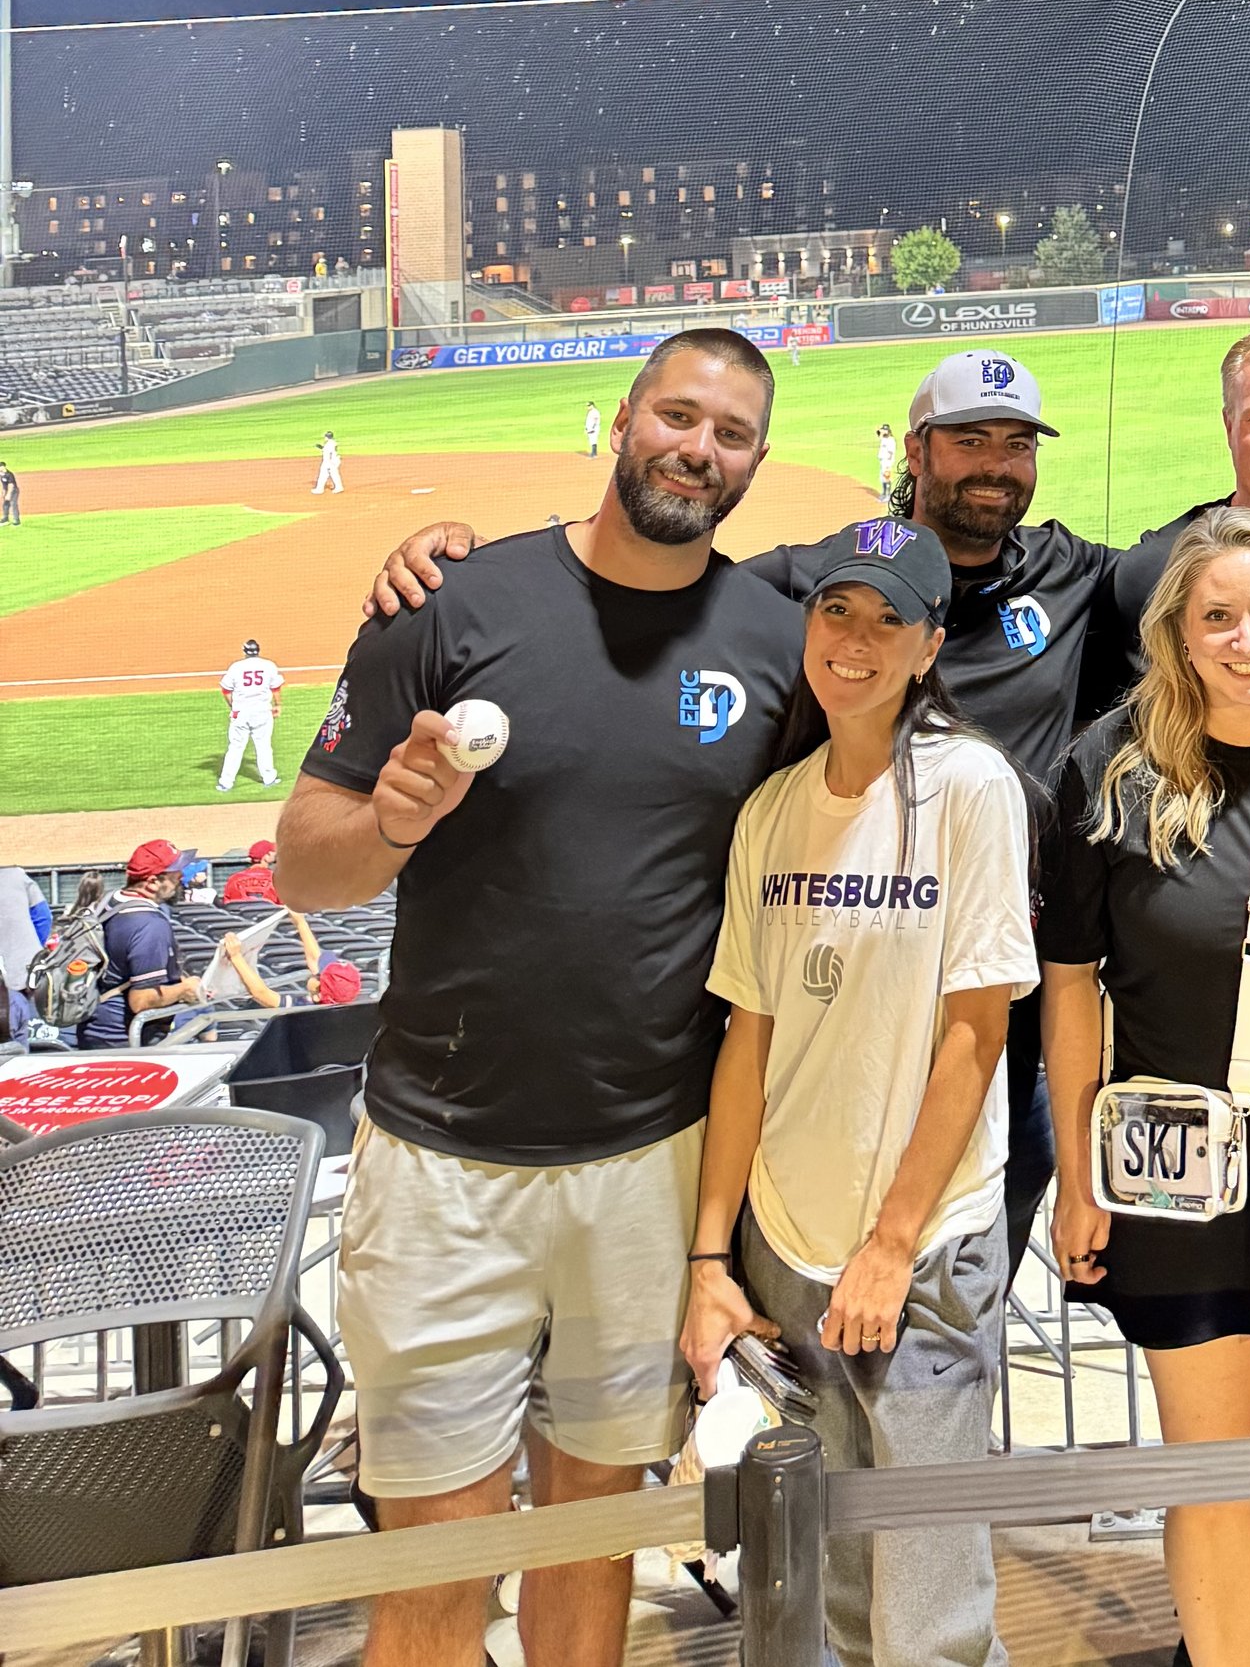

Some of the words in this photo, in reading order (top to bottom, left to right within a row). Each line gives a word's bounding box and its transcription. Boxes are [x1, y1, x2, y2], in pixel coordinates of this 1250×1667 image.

[939, 302, 1037, 322] LEXUS
[1176, 305, 1209, 314] INTREPID
[940, 322, 958, 332] OF
[960, 318, 1037, 331] HUNTSVILLE
[453, 347, 492, 365] GET
[494, 343, 546, 362] YOUR
[549, 340, 607, 359] GEAR!
[981, 359, 994, 384] EPIC
[854, 520, 918, 560] W
[996, 600, 1025, 650] EPIC
[242, 670, 264, 687] 55
[678, 669, 701, 727] EPIC
[761, 872, 941, 911] WHITESBURG
[765, 907, 930, 931] OLLEYBALL
[32, 1105, 123, 1114] PROGRESS
[72, 1094, 160, 1106] STOP!
[1120, 1119, 1188, 1183] SKJ
